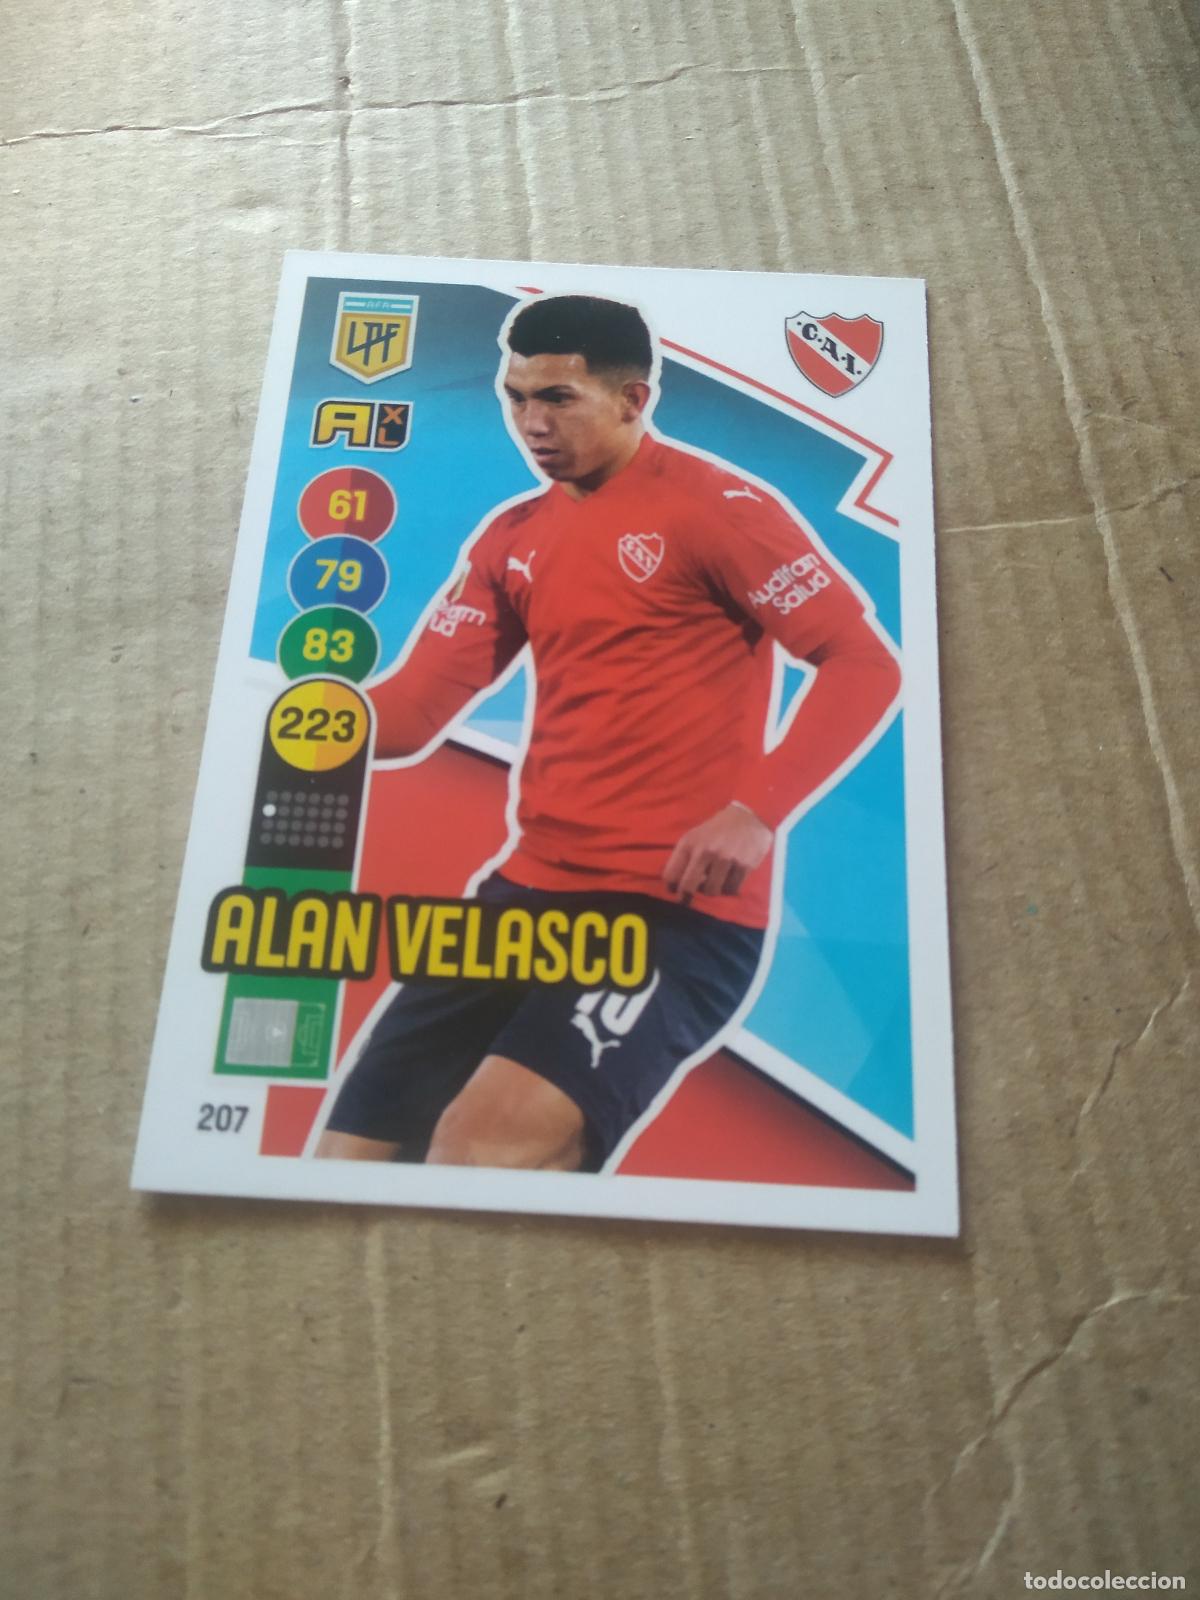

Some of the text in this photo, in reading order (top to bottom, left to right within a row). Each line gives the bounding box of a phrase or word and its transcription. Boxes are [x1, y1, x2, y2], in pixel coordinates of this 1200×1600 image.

[328, 489, 367, 521] 61
[316, 559, 362, 592] 79
[772, 567, 832, 615] Salud
[302, 627, 355, 663] 83
[277, 706, 357, 743] 223
[210, 893, 649, 988] ALAN VELASCO
[197, 1103, 249, 1133] 207
